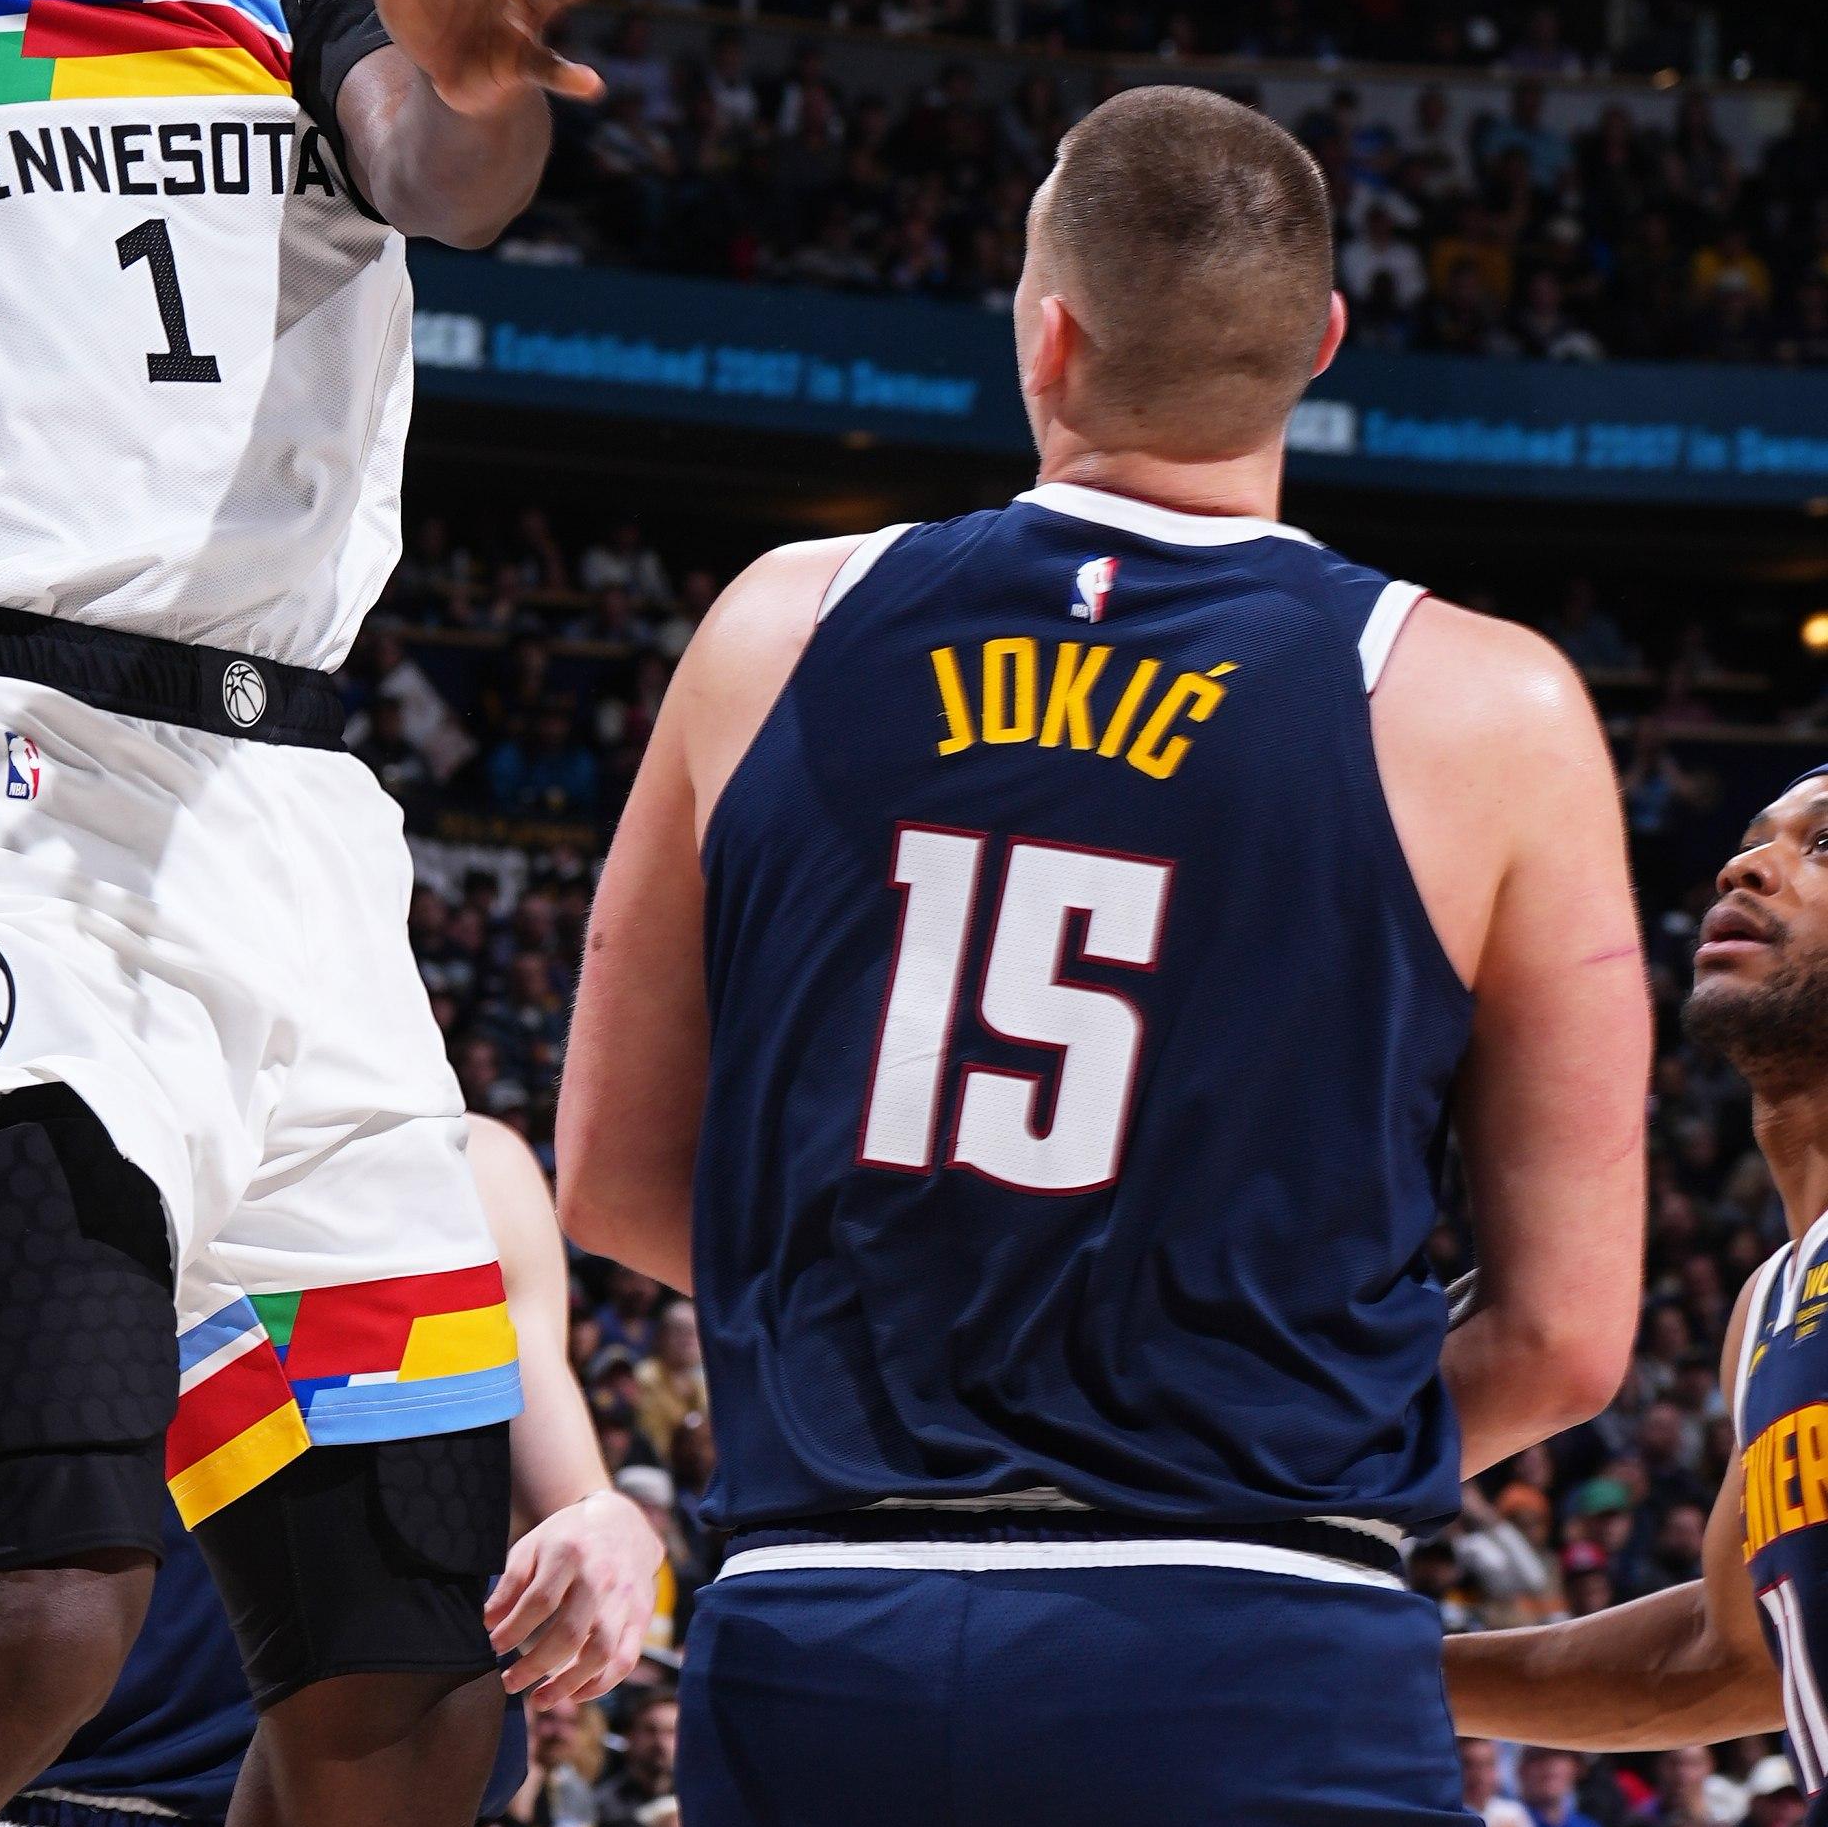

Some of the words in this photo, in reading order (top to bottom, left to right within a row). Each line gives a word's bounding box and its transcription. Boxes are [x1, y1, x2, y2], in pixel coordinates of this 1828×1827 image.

[115, 218, 222, 384] 1
[929, 636, 1242, 780] JOKIĆ
[856, 819, 1176, 1197] 15
